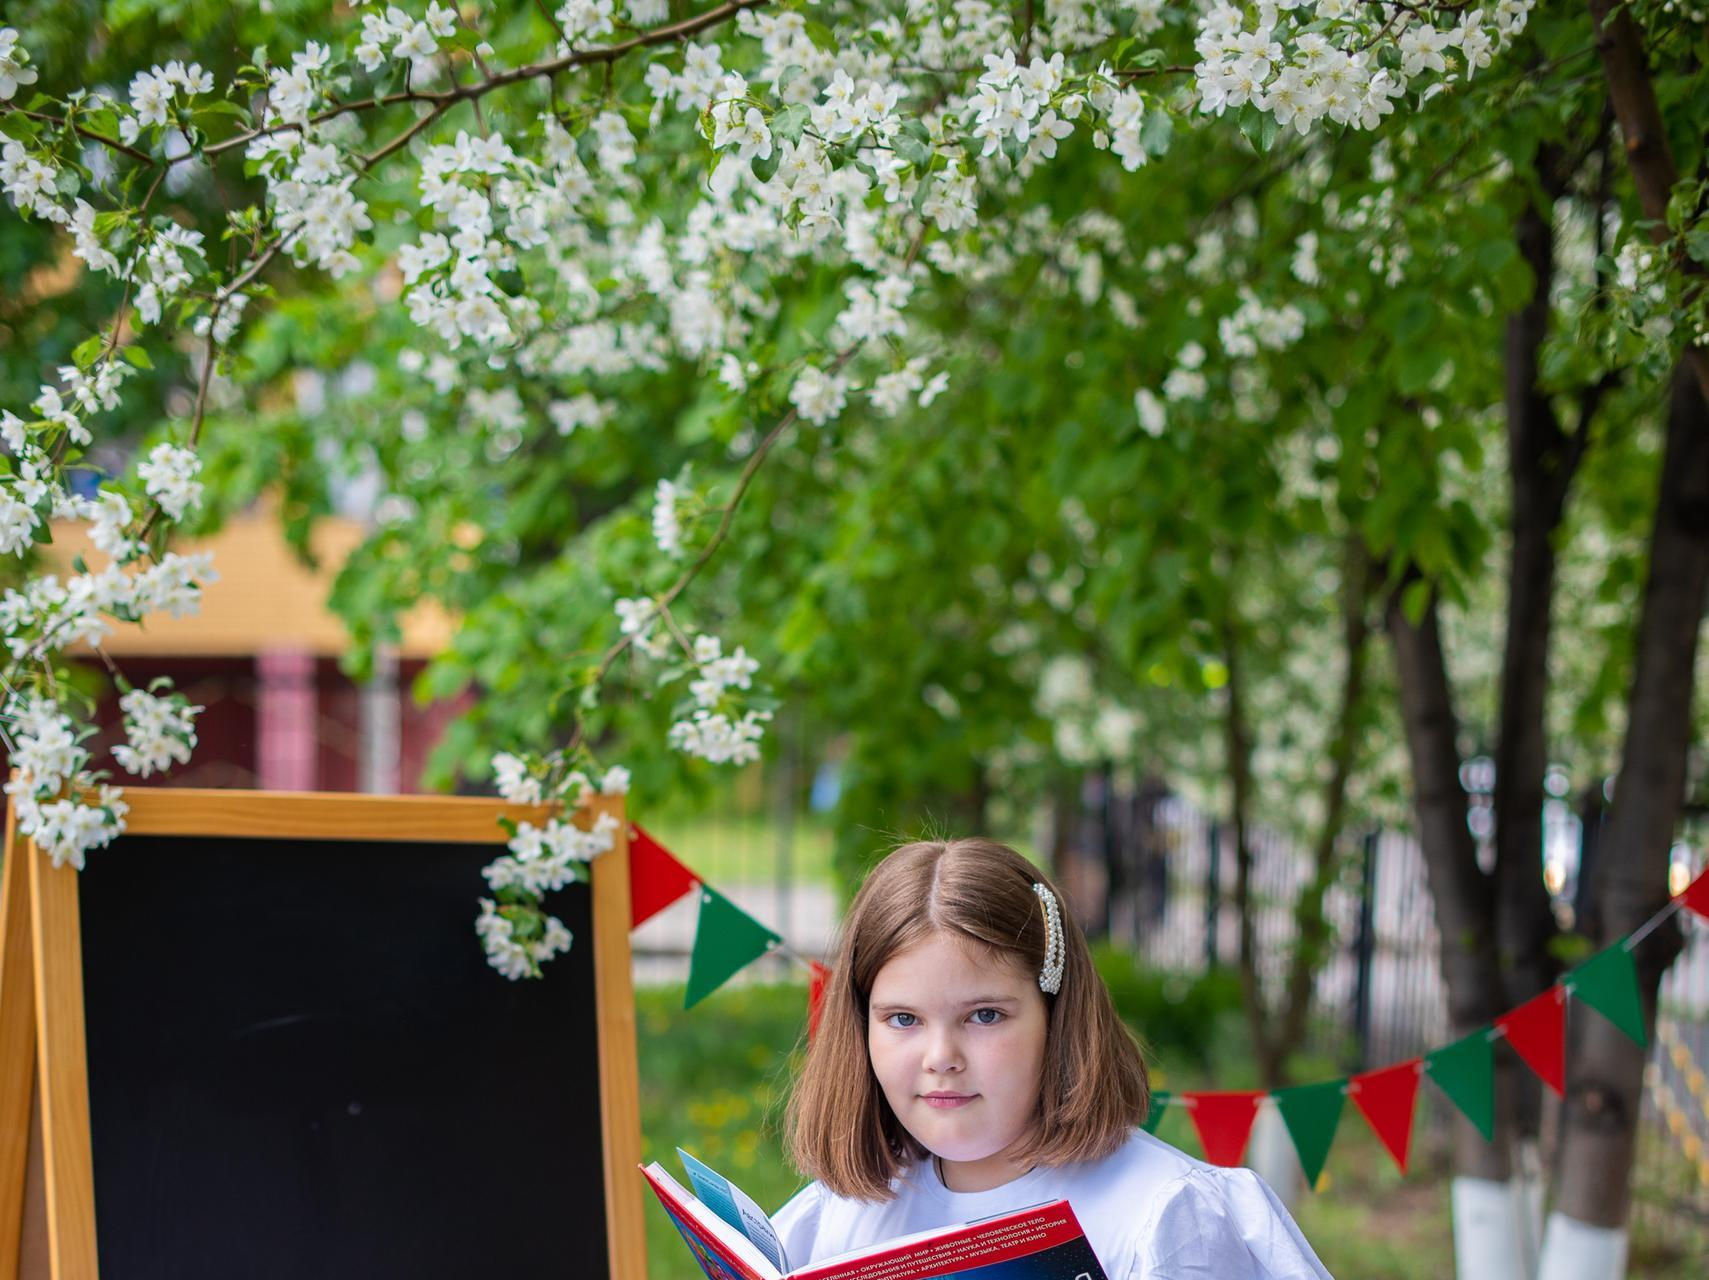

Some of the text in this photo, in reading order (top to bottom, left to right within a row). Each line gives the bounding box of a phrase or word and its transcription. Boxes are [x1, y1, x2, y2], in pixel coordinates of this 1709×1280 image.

[860, 1253, 912, 1272] ОКРУЖАЮЩИЙ
[914, 1249, 930, 1258] МИР
[934, 1238, 972, 1252] ЖИВОТНЫЕ
[976, 1222, 1028, 1239] ЧЕЛОВЕЧЕСКОЕ
[1028, 1217, 1046, 1226] ТЕЛО
[906, 1250, 952, 1268] ПУТЕШЕСТВИЯ
[956, 1244, 980, 1254] НАУКА
[987, 1228, 1031, 1244] ТЕХНОЛОГИЯ
[1036, 1218, 1068, 1232] ИСТОРИЯ
[921, 1255, 964, 1272] АРХИТЕКТУРА
[970, 1246, 1000, 1258] МУЗЫКА,
[1000, 1240, 1020, 1249] ТЕАТР
[1026, 1232, 1046, 1242] КИНО
